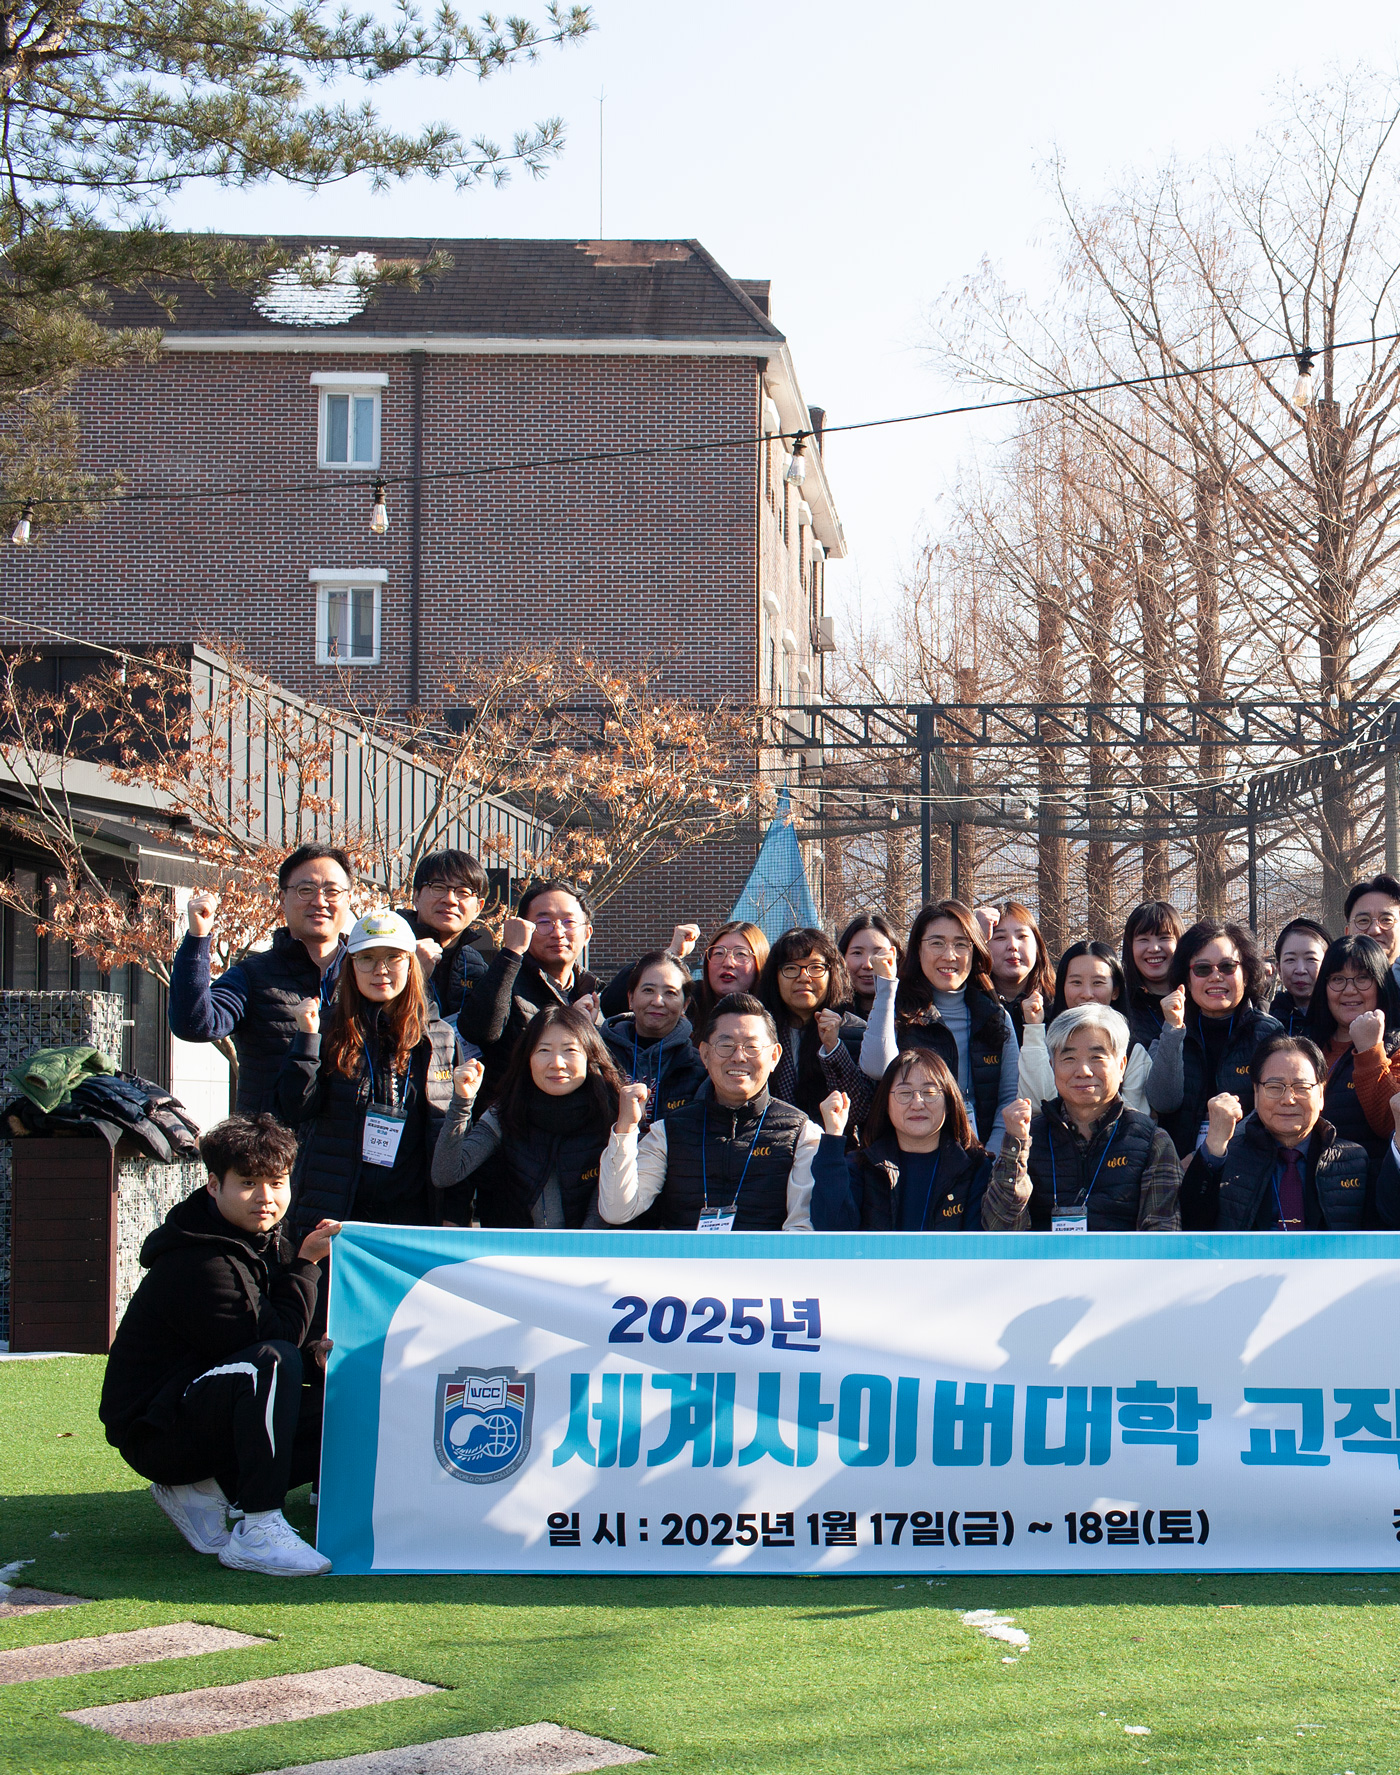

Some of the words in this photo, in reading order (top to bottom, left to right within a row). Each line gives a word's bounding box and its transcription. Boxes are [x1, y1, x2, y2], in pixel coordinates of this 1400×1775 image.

[608, 1296, 820, 1353] 2025년
[470, 1387, 501, 1398] WCC
[553, 1371, 1212, 1469] 세계사이버대학
[547, 1512, 582, 1548] 일
[660, 1511, 795, 1548] 2025년
[807, 1510, 858, 1548] 1월
[870, 1510, 1015, 1548] 17일(금)
[1065, 1508, 1210, 1548] 18일(토)
